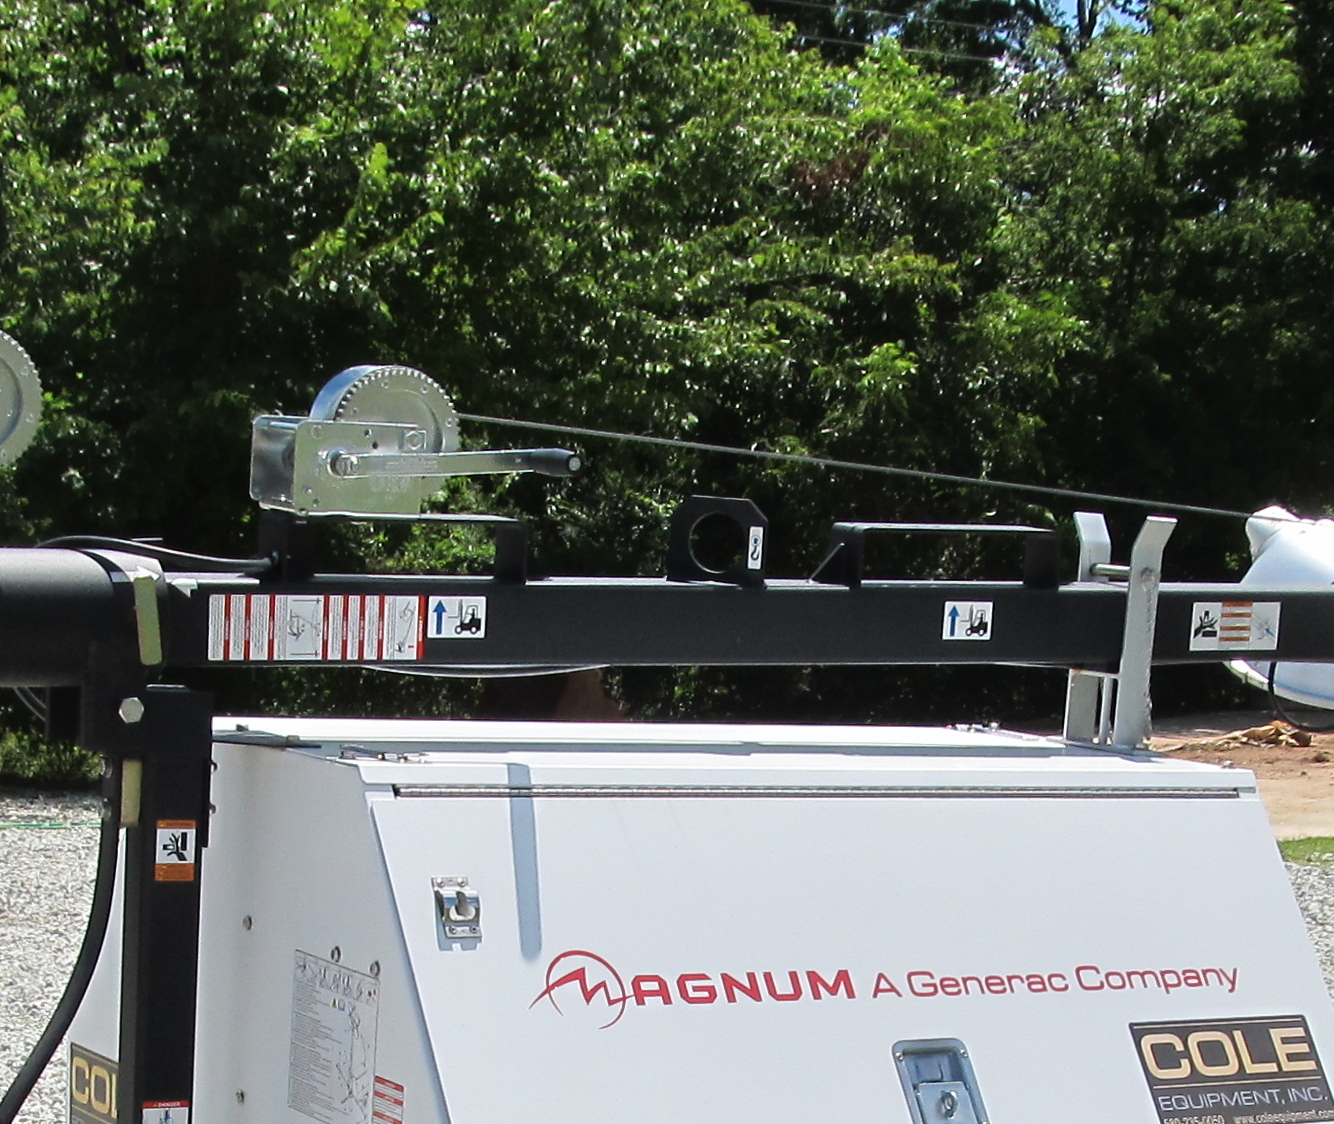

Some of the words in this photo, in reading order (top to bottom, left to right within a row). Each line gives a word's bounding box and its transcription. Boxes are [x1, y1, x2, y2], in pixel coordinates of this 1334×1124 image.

[528, 966, 857, 1011] MAGNUM
[872, 971, 903, 999] A
[906, 970, 1070, 998] Generac
[1074, 964, 1239, 994] Company
[1140, 1026, 1318, 1080] COLE
[72, 1056, 118, 1119] COL
[1157, 1088, 1286, 1112] EQUIPMENT,
[1288, 1086, 1329, 1104] INC.
